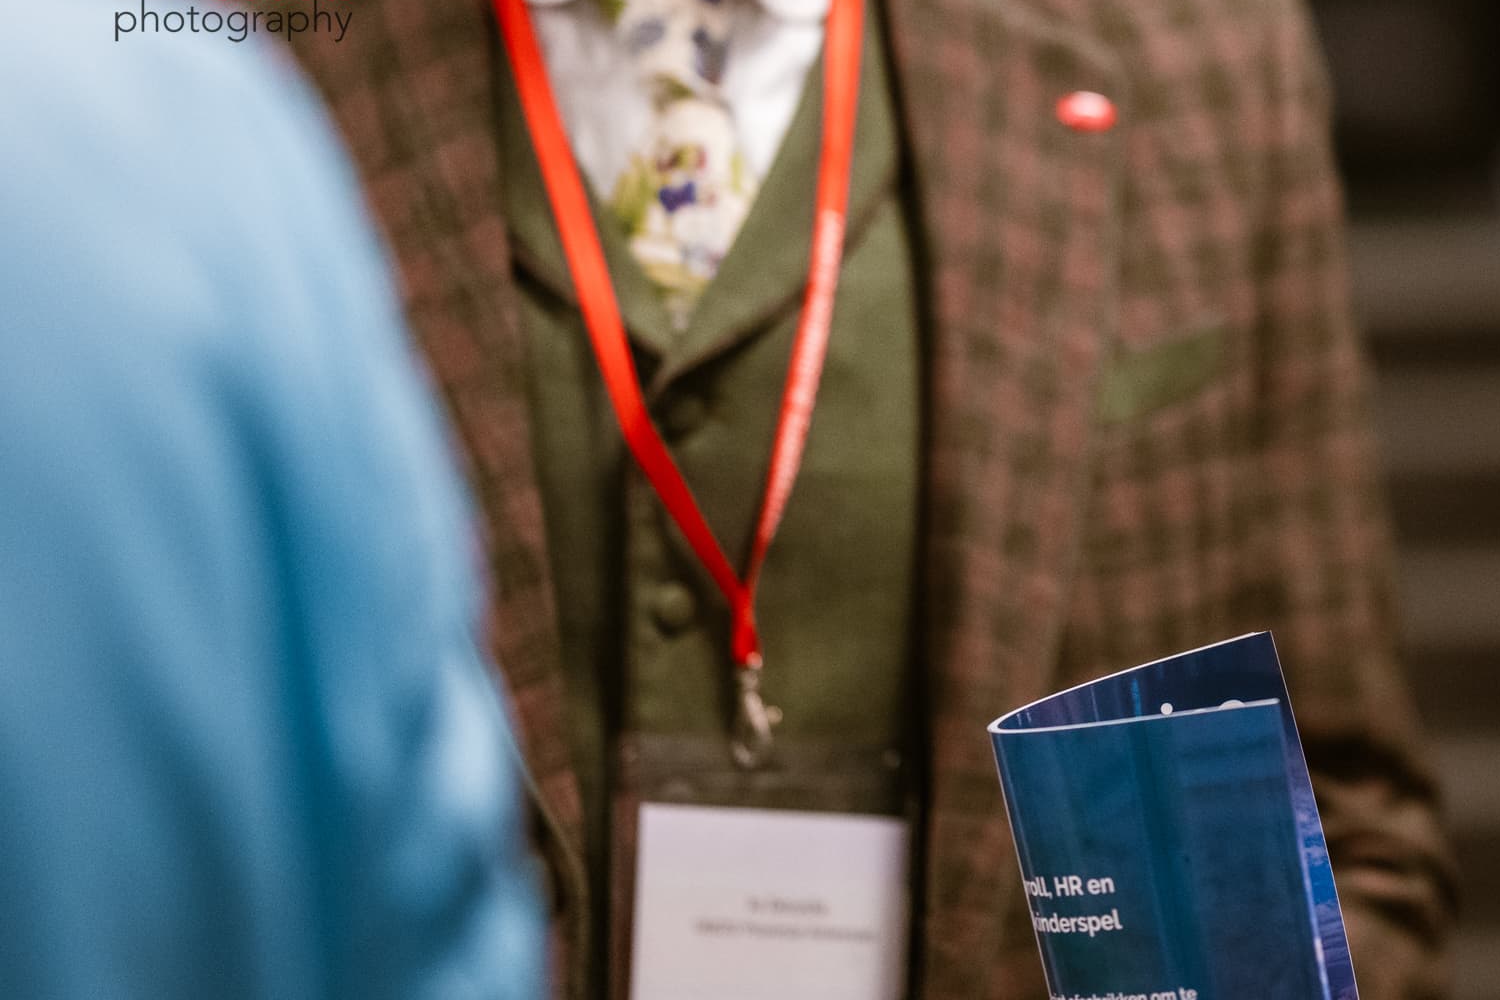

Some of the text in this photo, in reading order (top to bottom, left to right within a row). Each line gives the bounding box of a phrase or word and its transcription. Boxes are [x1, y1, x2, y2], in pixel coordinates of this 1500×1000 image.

[1053, 875, 1084, 897] HR
[1087, 877, 1116, 895] en
[1033, 908, 1124, 938] inderspel
